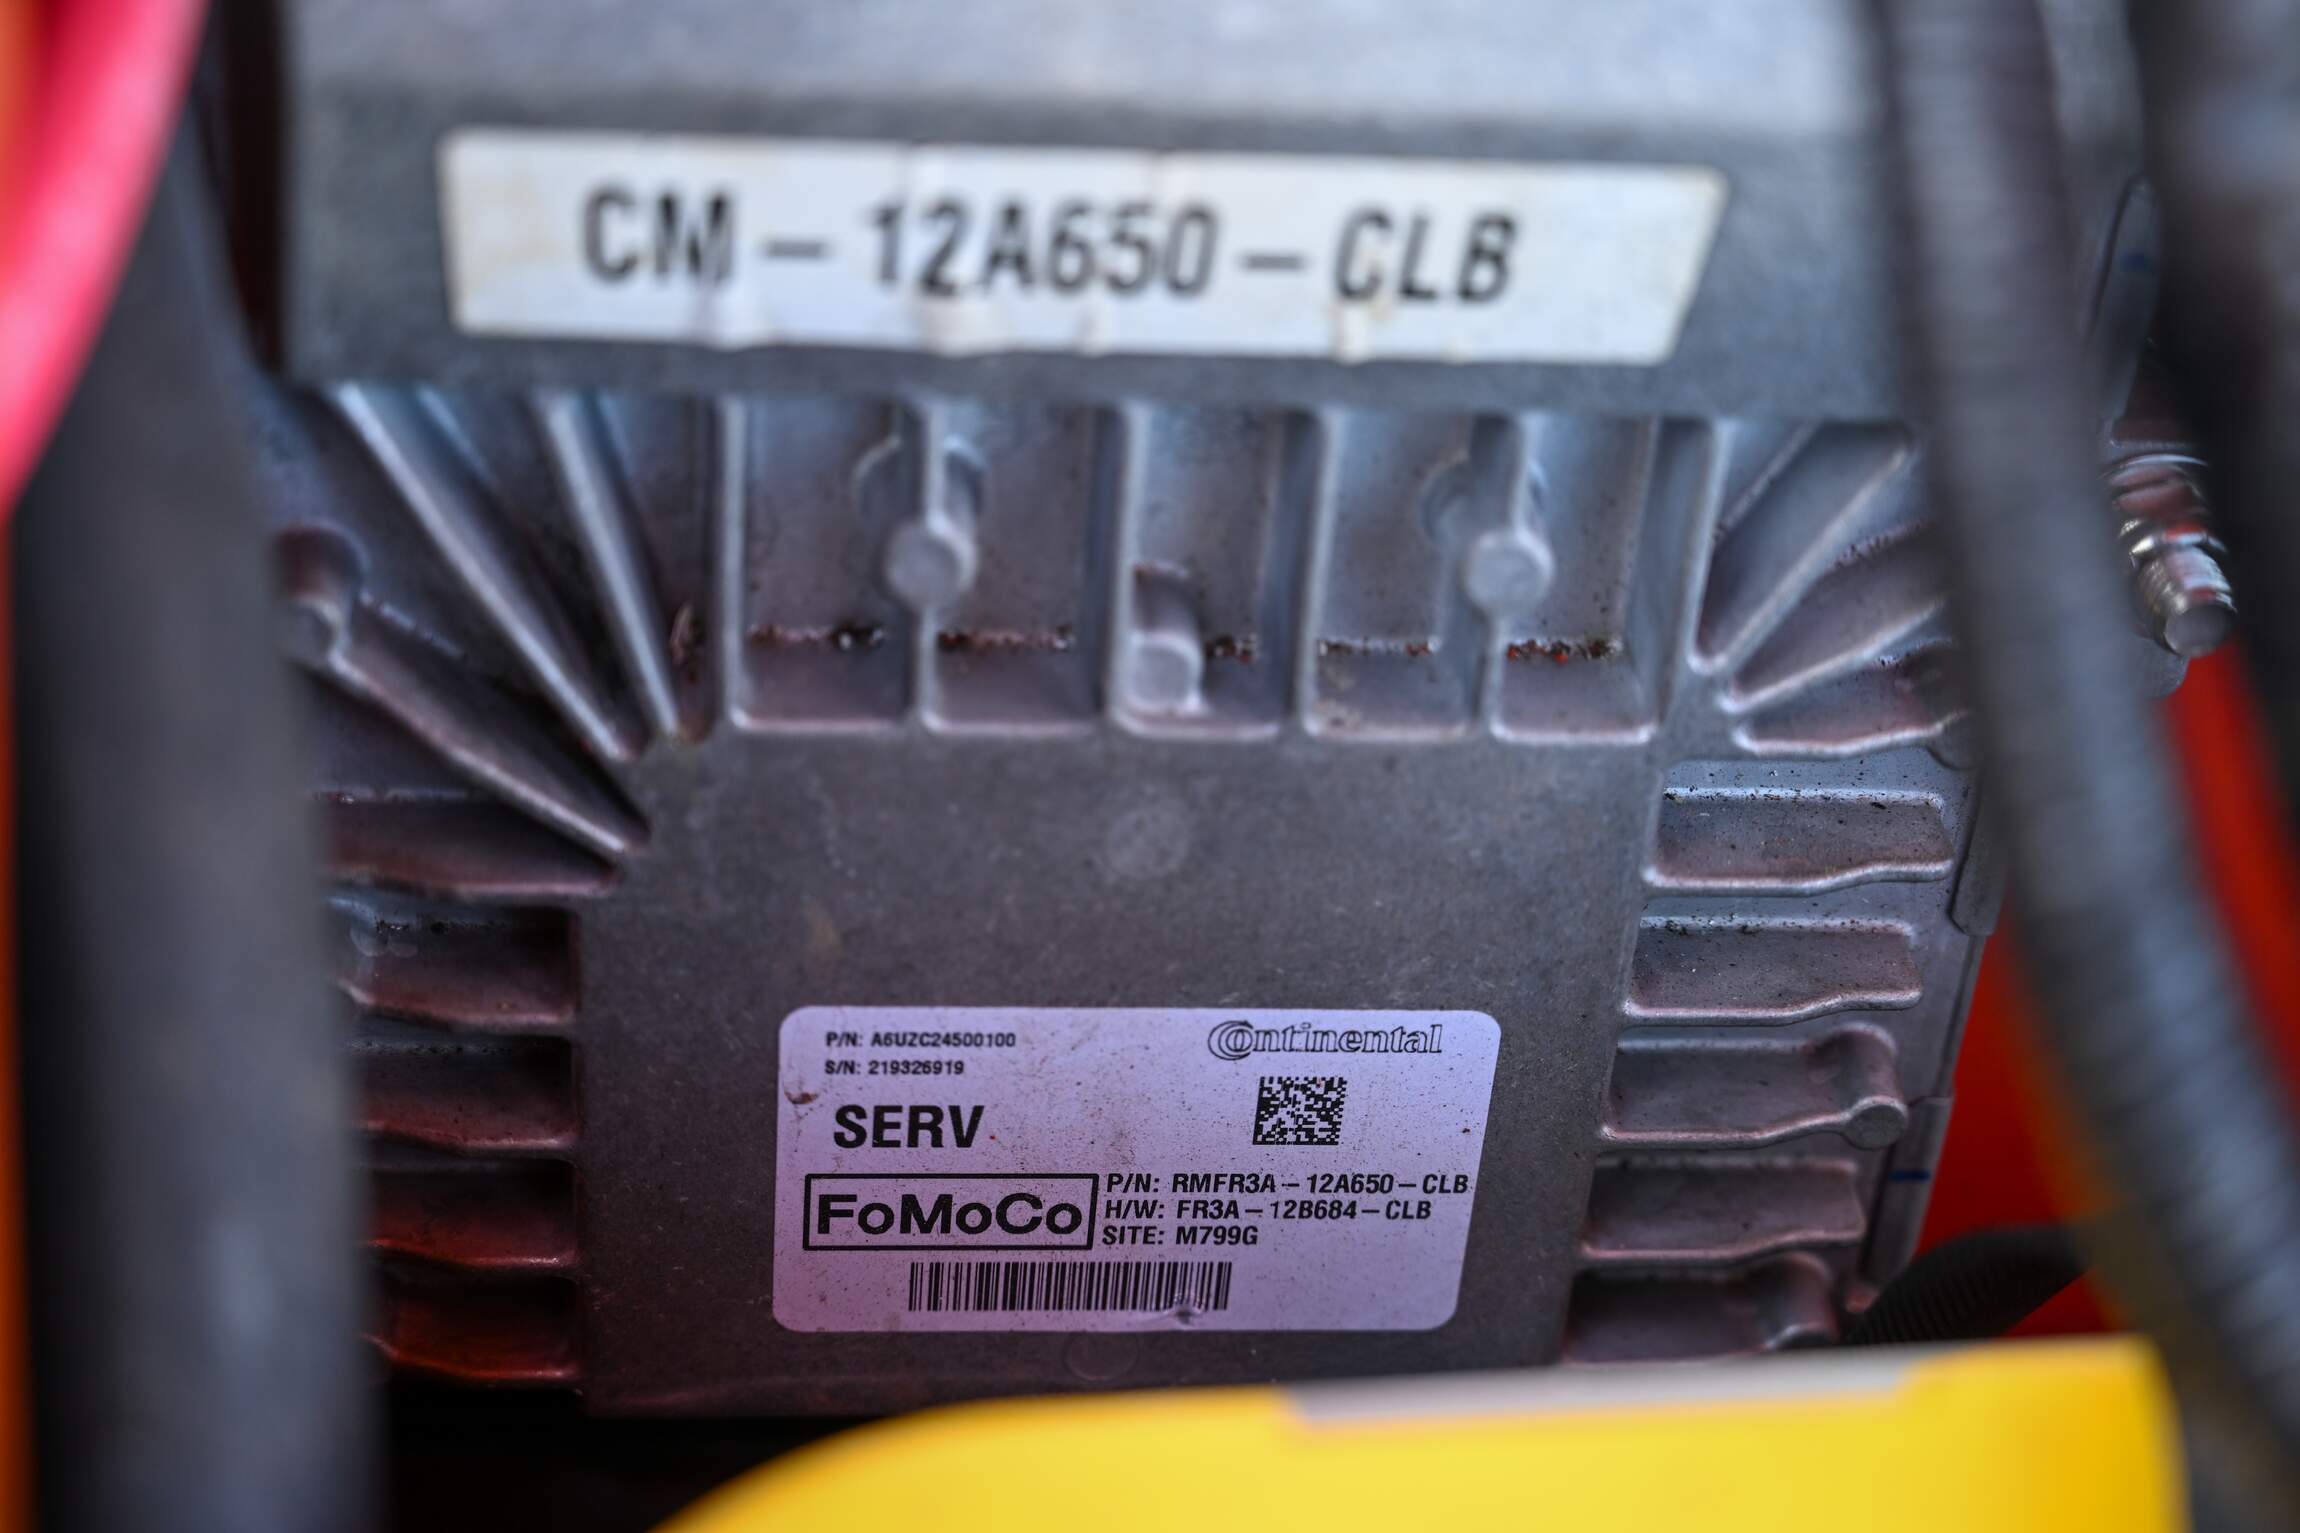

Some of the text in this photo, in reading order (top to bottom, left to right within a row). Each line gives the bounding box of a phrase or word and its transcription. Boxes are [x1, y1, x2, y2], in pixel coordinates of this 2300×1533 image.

[825, 1032, 862, 1048] P/N:
[1207, 1019, 1443, 1061] Continental
[824, 1060, 965, 1075] S/N: 219326919
[833, 1105, 985, 1148] SERV
[1106, 1173, 1160, 1194] P/N:
[816, 1192, 1083, 1235] FoMoCo
[1104, 1199, 1165, 1220] H/W:
[1102, 1225, 1259, 1246] SITE: M799G
